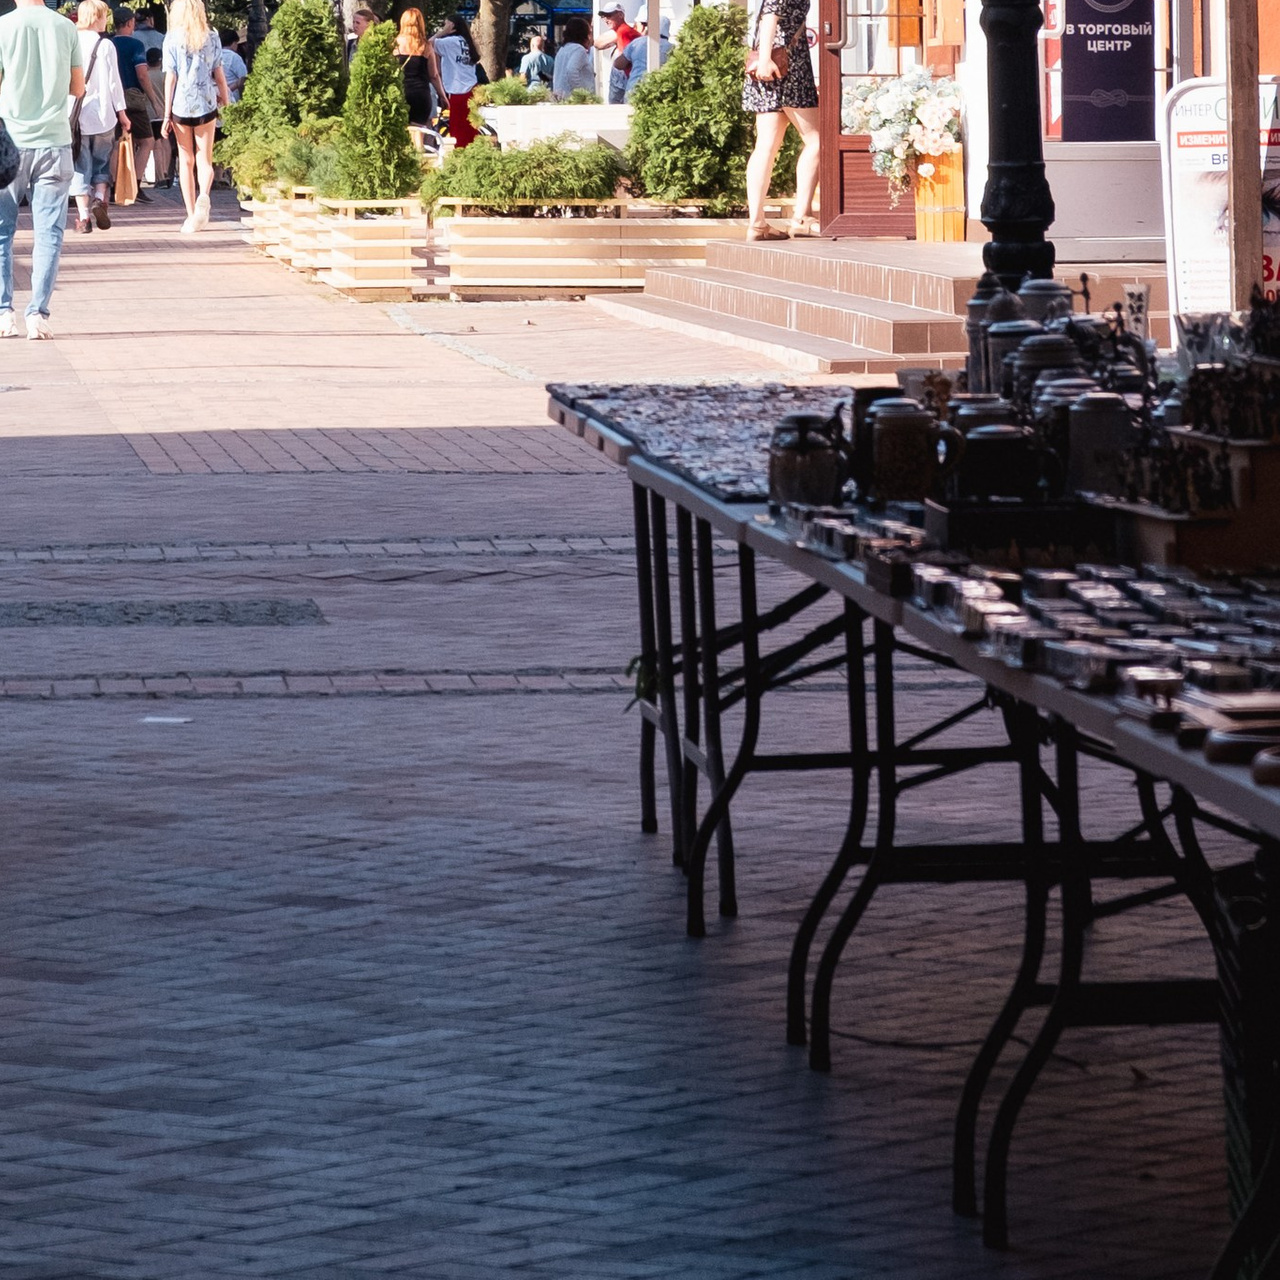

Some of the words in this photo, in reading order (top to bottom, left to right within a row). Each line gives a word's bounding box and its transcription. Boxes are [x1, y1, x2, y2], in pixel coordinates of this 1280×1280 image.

[1065, 23, 1075, 35] В
[1078, 21, 1153, 36] ТОРГОВЫЙ
[1086, 39, 1132, 53] ЦЕНТР
[1175, 103, 1212, 117] ИНТЕР
